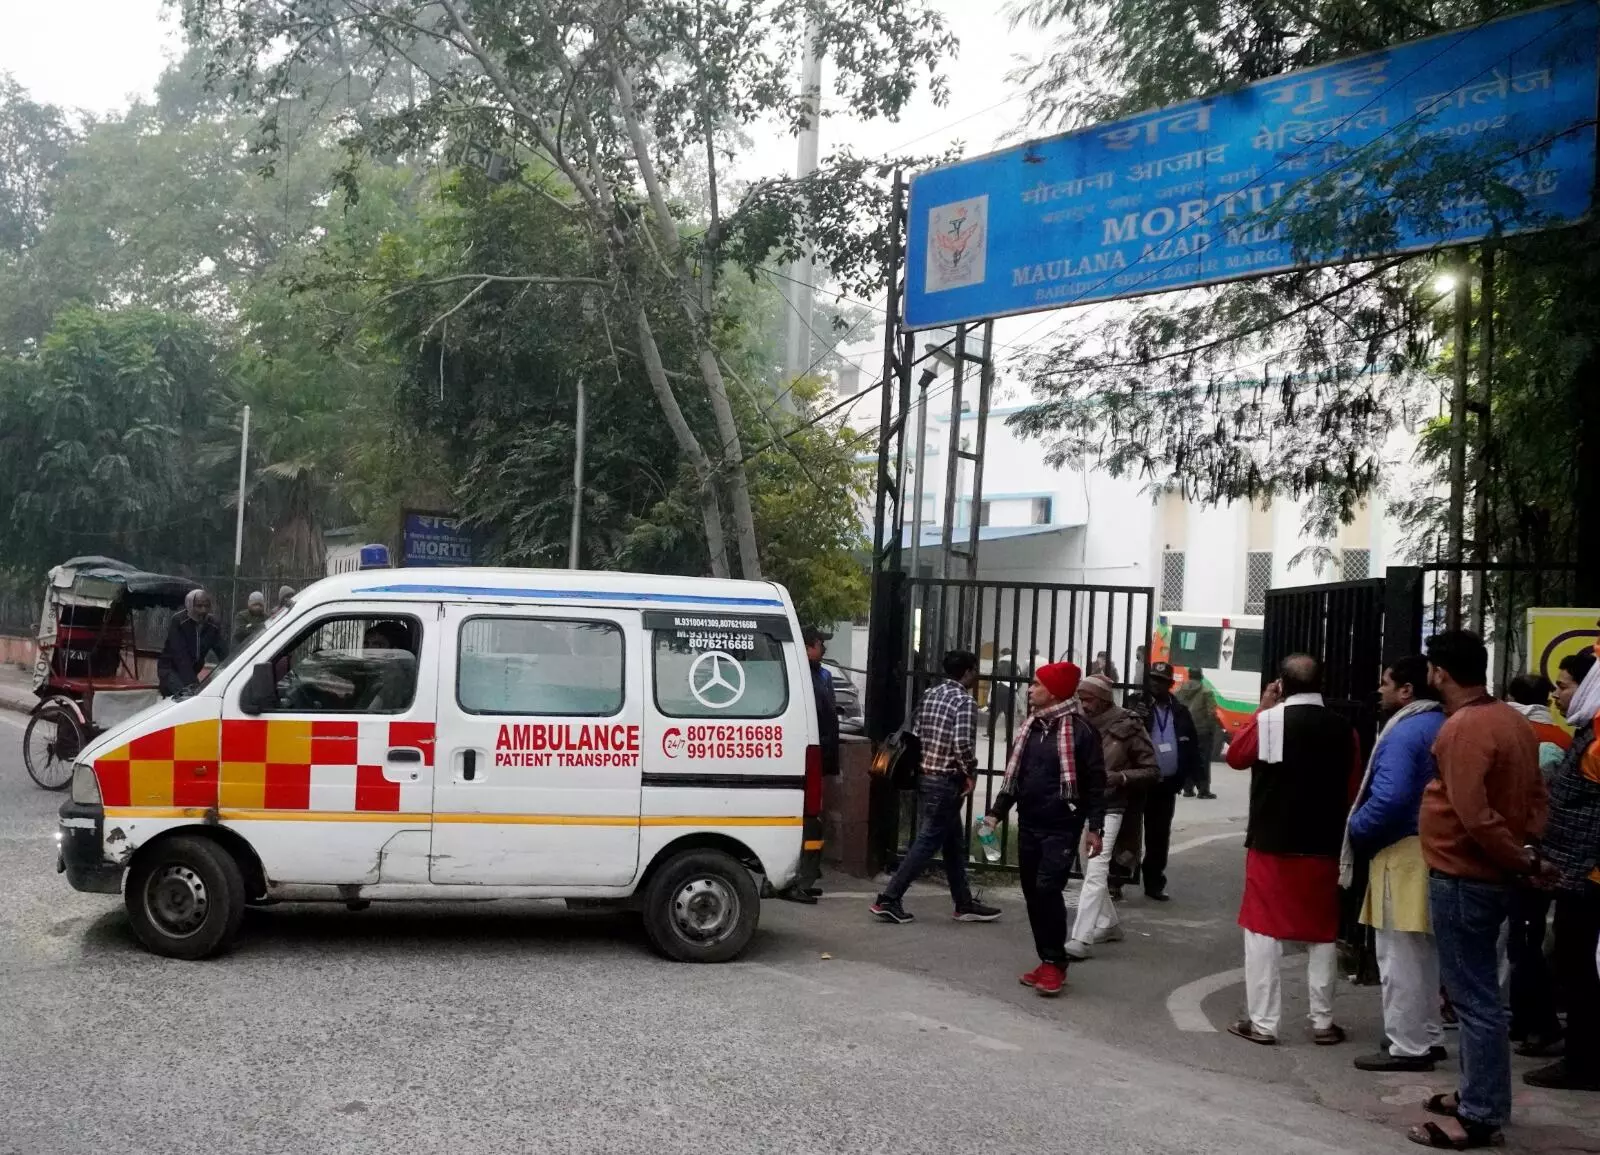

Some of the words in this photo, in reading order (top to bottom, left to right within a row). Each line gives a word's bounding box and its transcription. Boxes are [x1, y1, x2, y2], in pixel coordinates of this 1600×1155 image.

[1097, 104, 1216, 150] शव
[1262, 59, 1392, 115] गृह
[1021, 171, 1114, 205] मौलाना
[1127, 144, 1230, 182] आजाद
[1251, 107, 1388, 151] मेडिकल
[1012, 250, 1127, 287] MAULANA
[1138, 233, 1211, 264] AZAD
[412, 540, 472, 557] MORTU
[689, 639, 754, 650] 8076216688
[495, 724, 640, 751] AMBULANCE
[687, 726, 783, 741] 8076216688
[667, 738, 685, 750] 24/7
[687, 743, 783, 758] 9910535613
[495, 753, 552, 767] PATIENT
[557, 753, 639, 767] TRANSPORT
